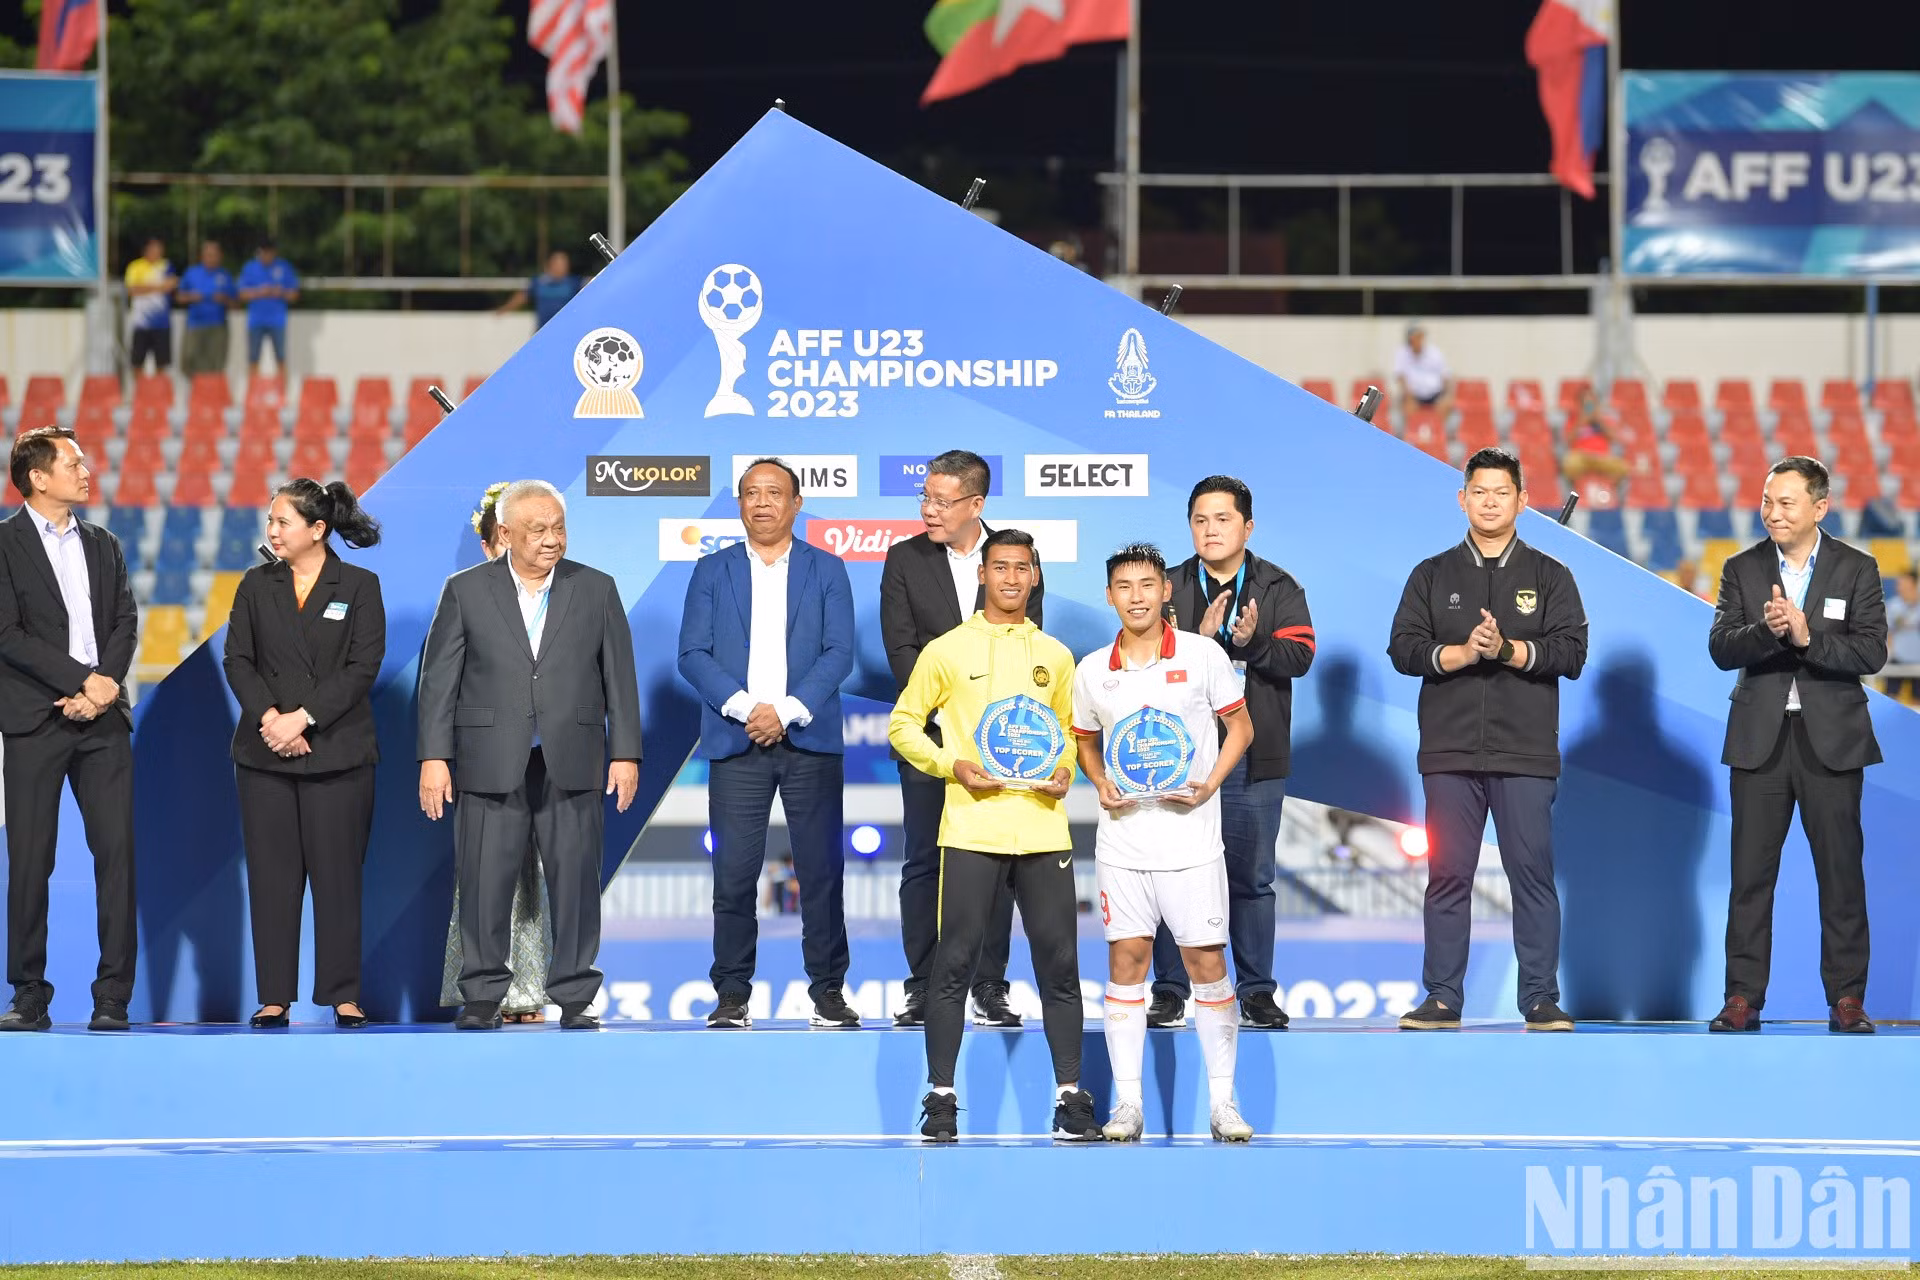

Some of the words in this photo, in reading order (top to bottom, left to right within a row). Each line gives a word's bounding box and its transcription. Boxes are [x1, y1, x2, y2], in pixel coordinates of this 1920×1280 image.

[1682, 152, 1811, 201] AFF
[768, 329, 843, 357] AFF
[853, 329, 924, 357] U23
[767, 359, 1058, 388] CHAMPIONSHIP
[767, 390, 859, 418] 2023
[1104, 409, 1116, 418] FA
[1117, 409, 1161, 418] THAILAND
[801, 468, 847, 487] IMS
[1040, 463, 1133, 487] SELECT
[1012, 748, 1044, 758] SCORER
[1143, 760, 1175, 769] SCORER
[1272, 979, 1418, 1018] 023
